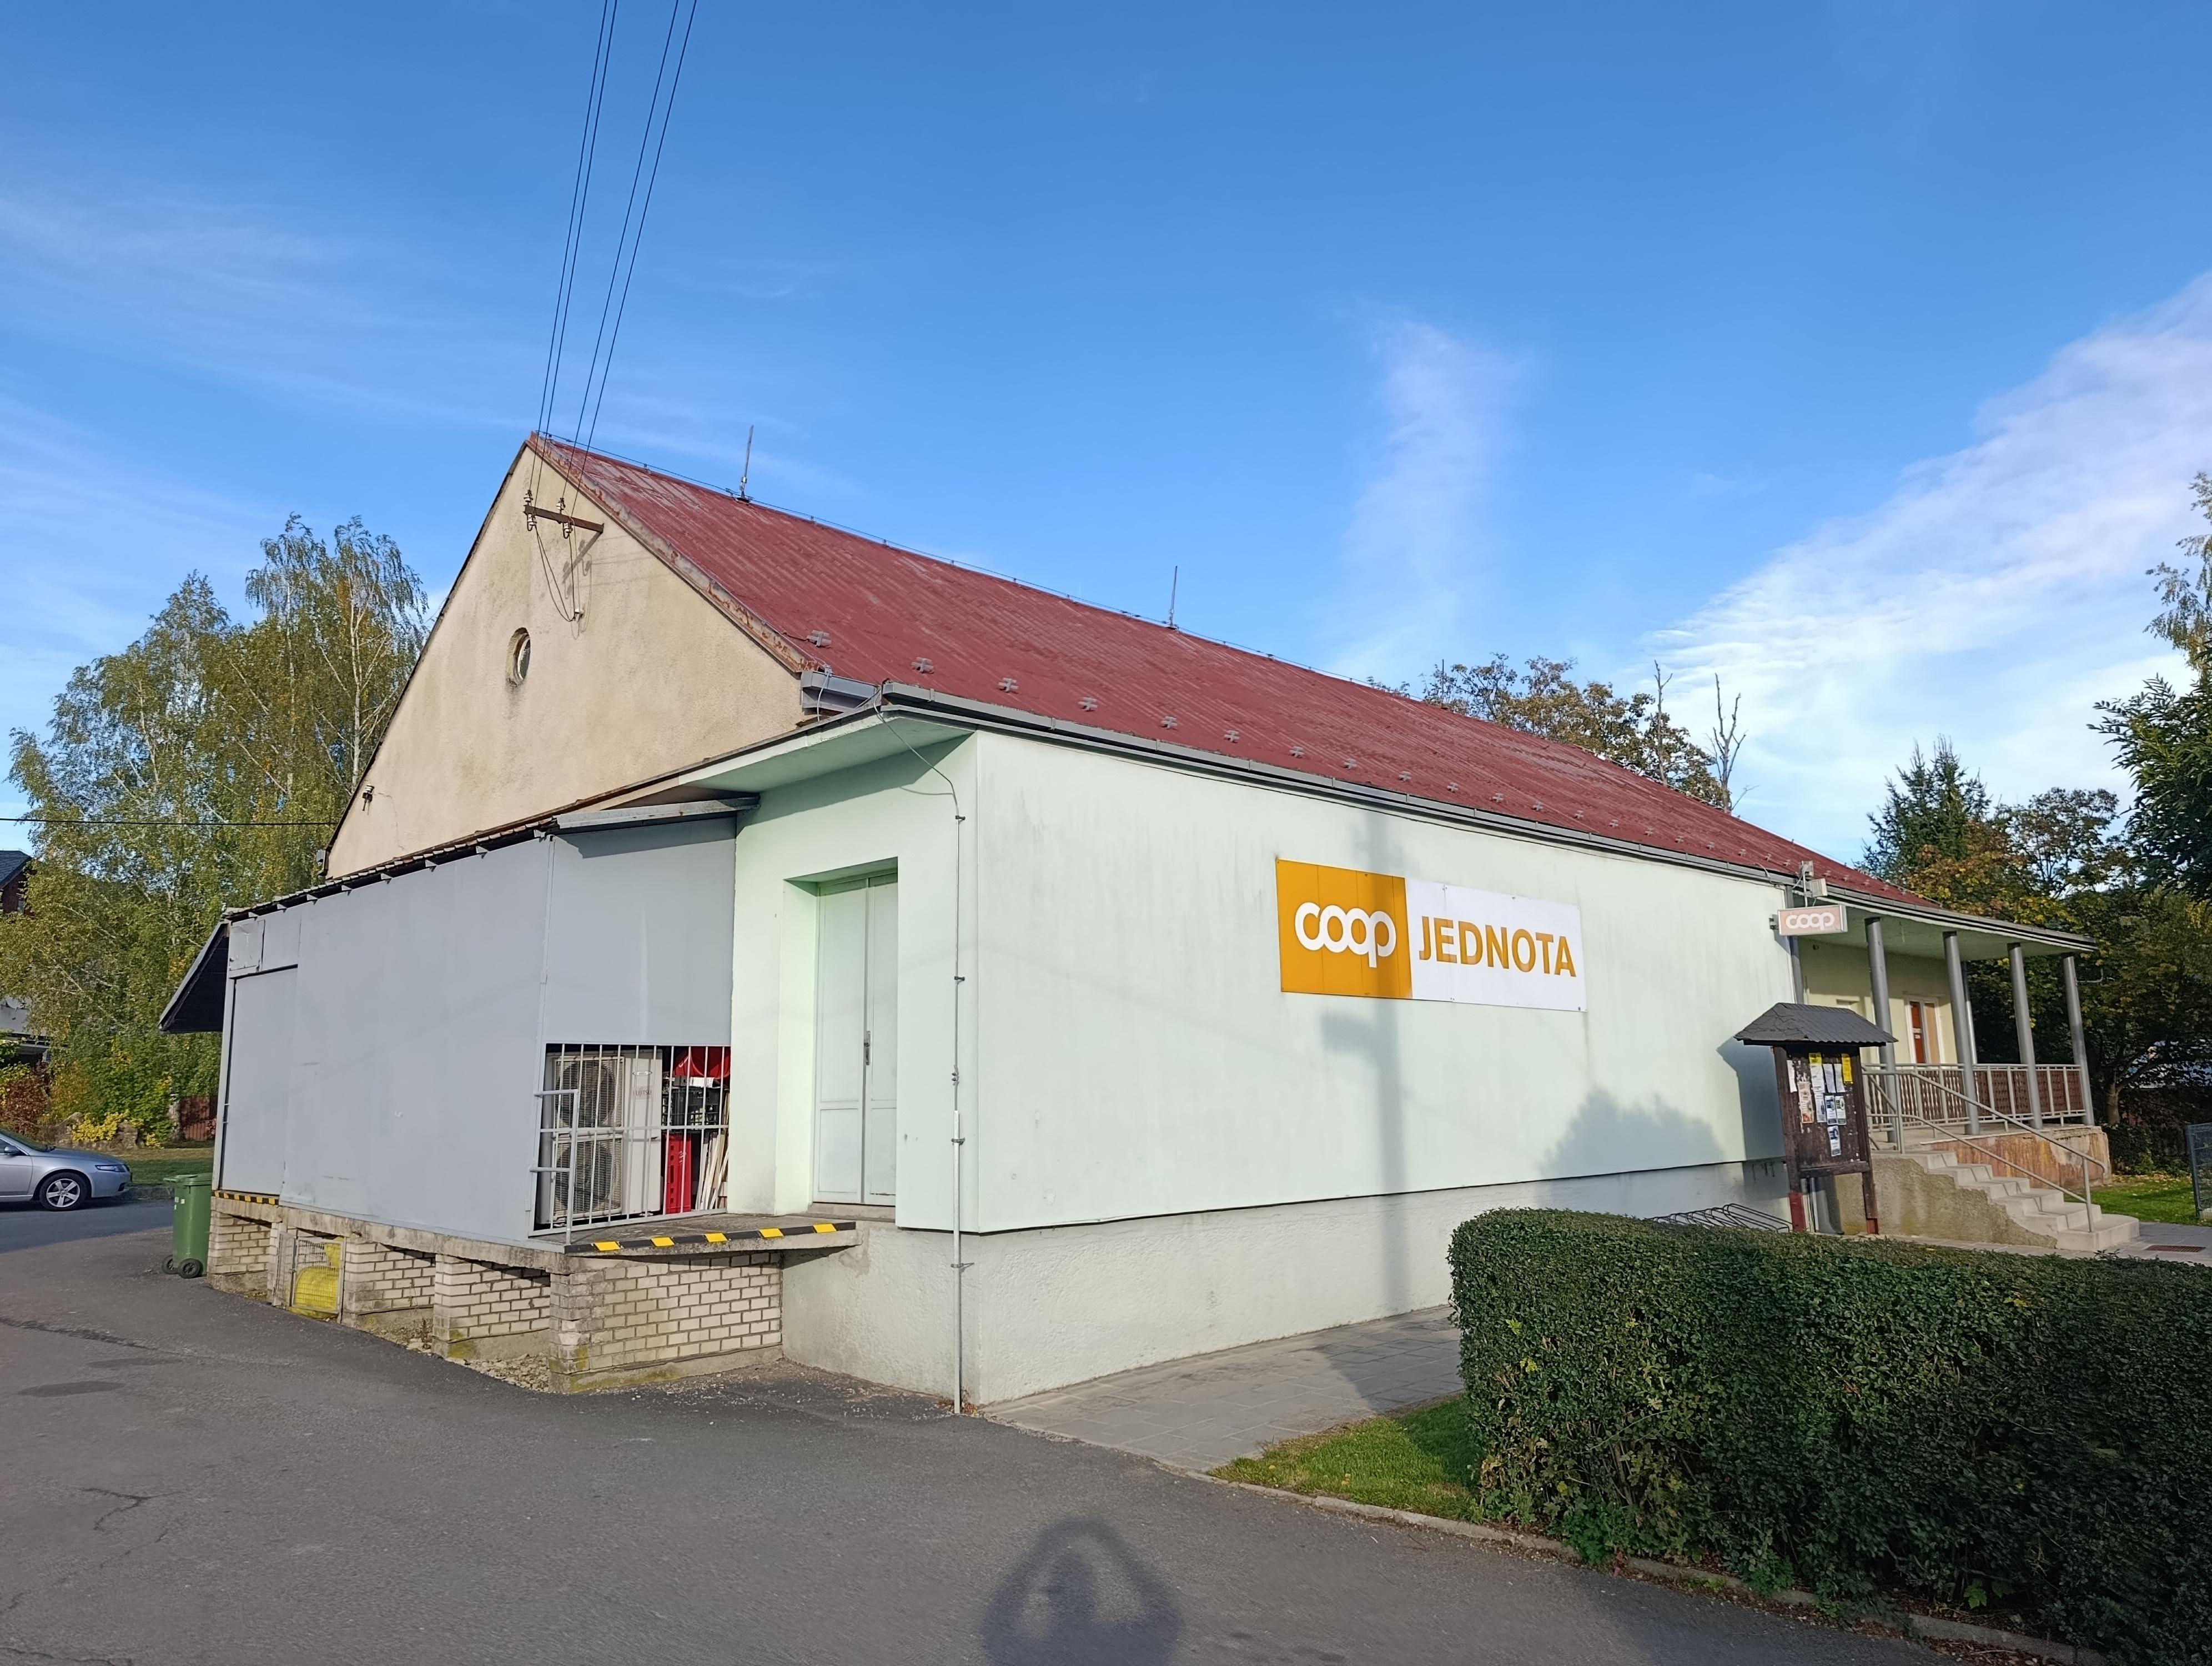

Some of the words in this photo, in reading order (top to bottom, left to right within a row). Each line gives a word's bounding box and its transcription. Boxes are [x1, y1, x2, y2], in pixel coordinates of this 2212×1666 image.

[1295, 902, 1396, 968] coop
[1419, 916, 1576, 977] JEDNOTA
[1786, 912, 1834, 931] coop
